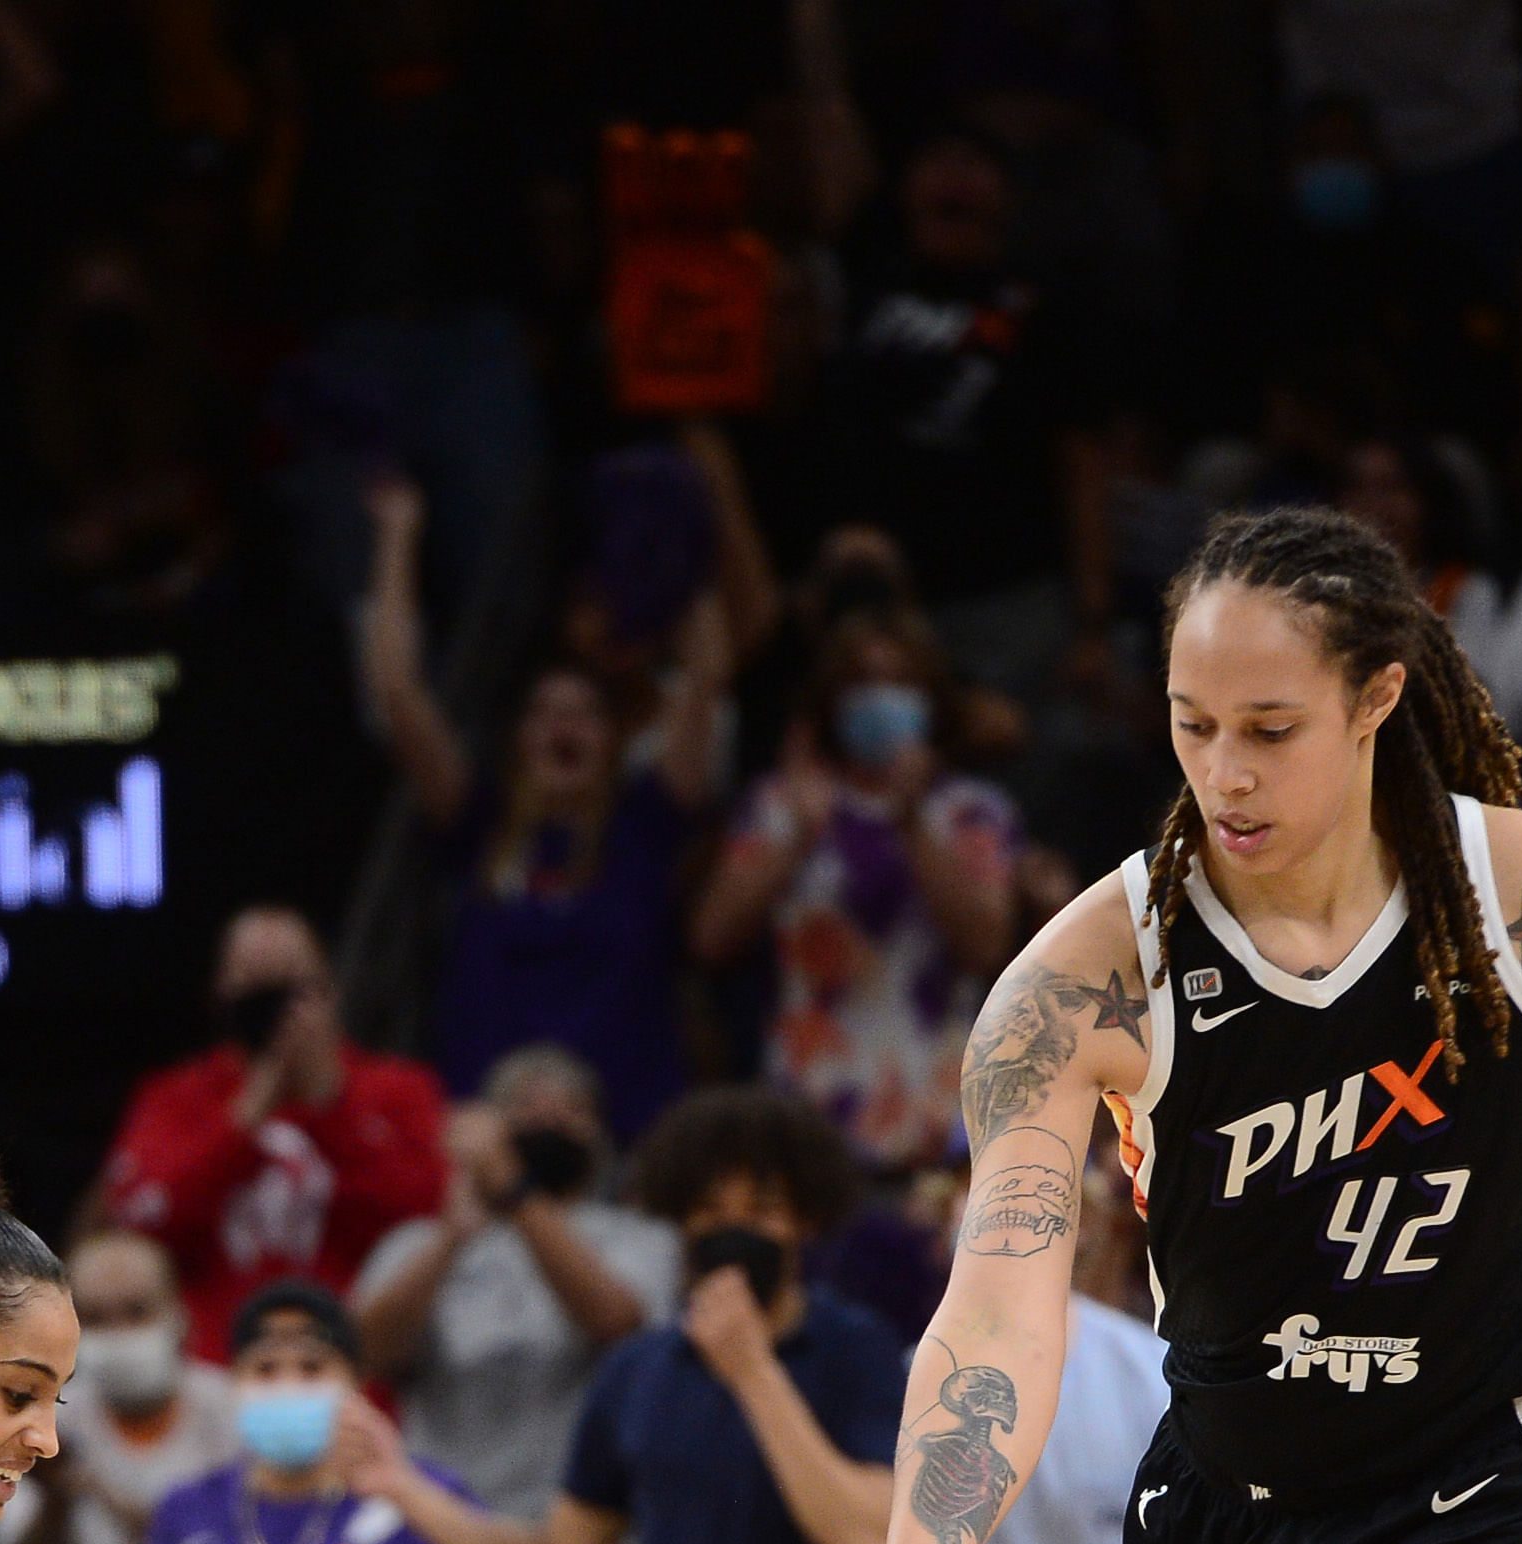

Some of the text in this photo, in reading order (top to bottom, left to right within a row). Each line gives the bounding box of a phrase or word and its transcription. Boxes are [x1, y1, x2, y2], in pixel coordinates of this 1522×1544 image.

[1215, 1038, 1447, 1199] PHX
[1326, 1168, 1471, 1281] 42
[1262, 1313, 1421, 1392] fry's
